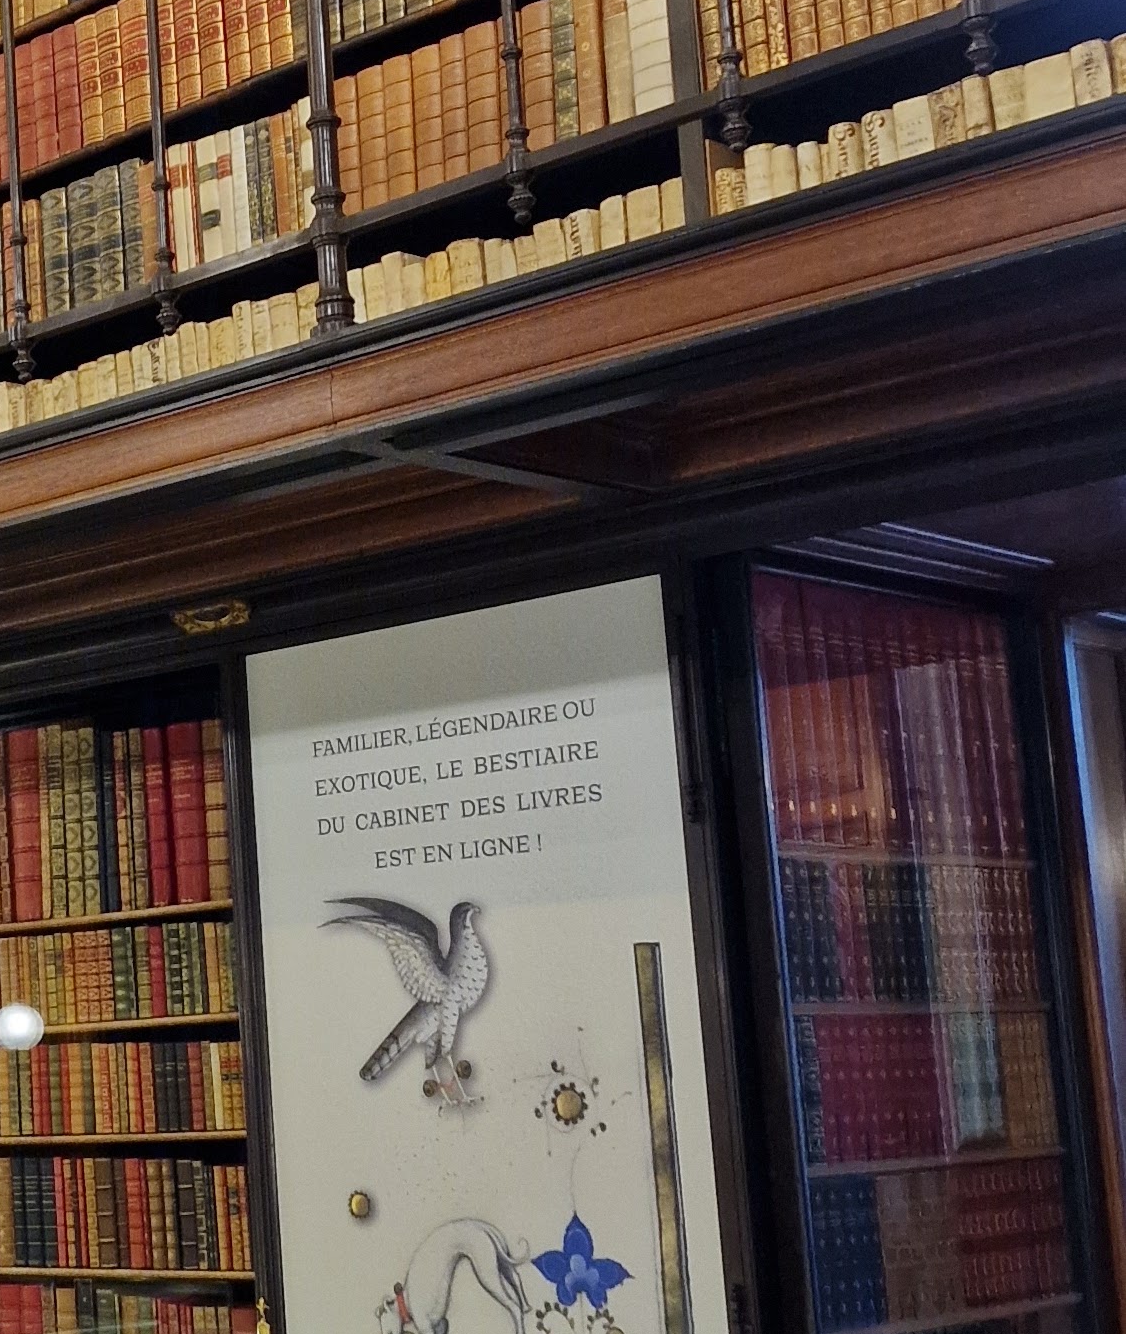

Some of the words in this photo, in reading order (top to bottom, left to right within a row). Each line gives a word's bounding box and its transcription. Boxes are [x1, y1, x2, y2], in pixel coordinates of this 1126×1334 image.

[312, 728, 413, 758] FAMILIER,
[415, 704, 558, 742] LÉGENDAIRE
[562, 698, 597, 720] OU
[315, 766, 428, 797] EXOTIQUE,
[436, 759, 464, 781] LE
[473, 740, 600, 776] BESTIAIRE
[318, 816, 346, 836] DU
[355, 803, 450, 831] CABINET
[461, 796, 506, 819] DES
[517, 784, 603, 811] LIVRES
[374, 848, 417, 869] EST
[422, 843, 454, 864] EN
[460, 834, 531, 859] LIGNE
[537, 834, 543, 852] !
